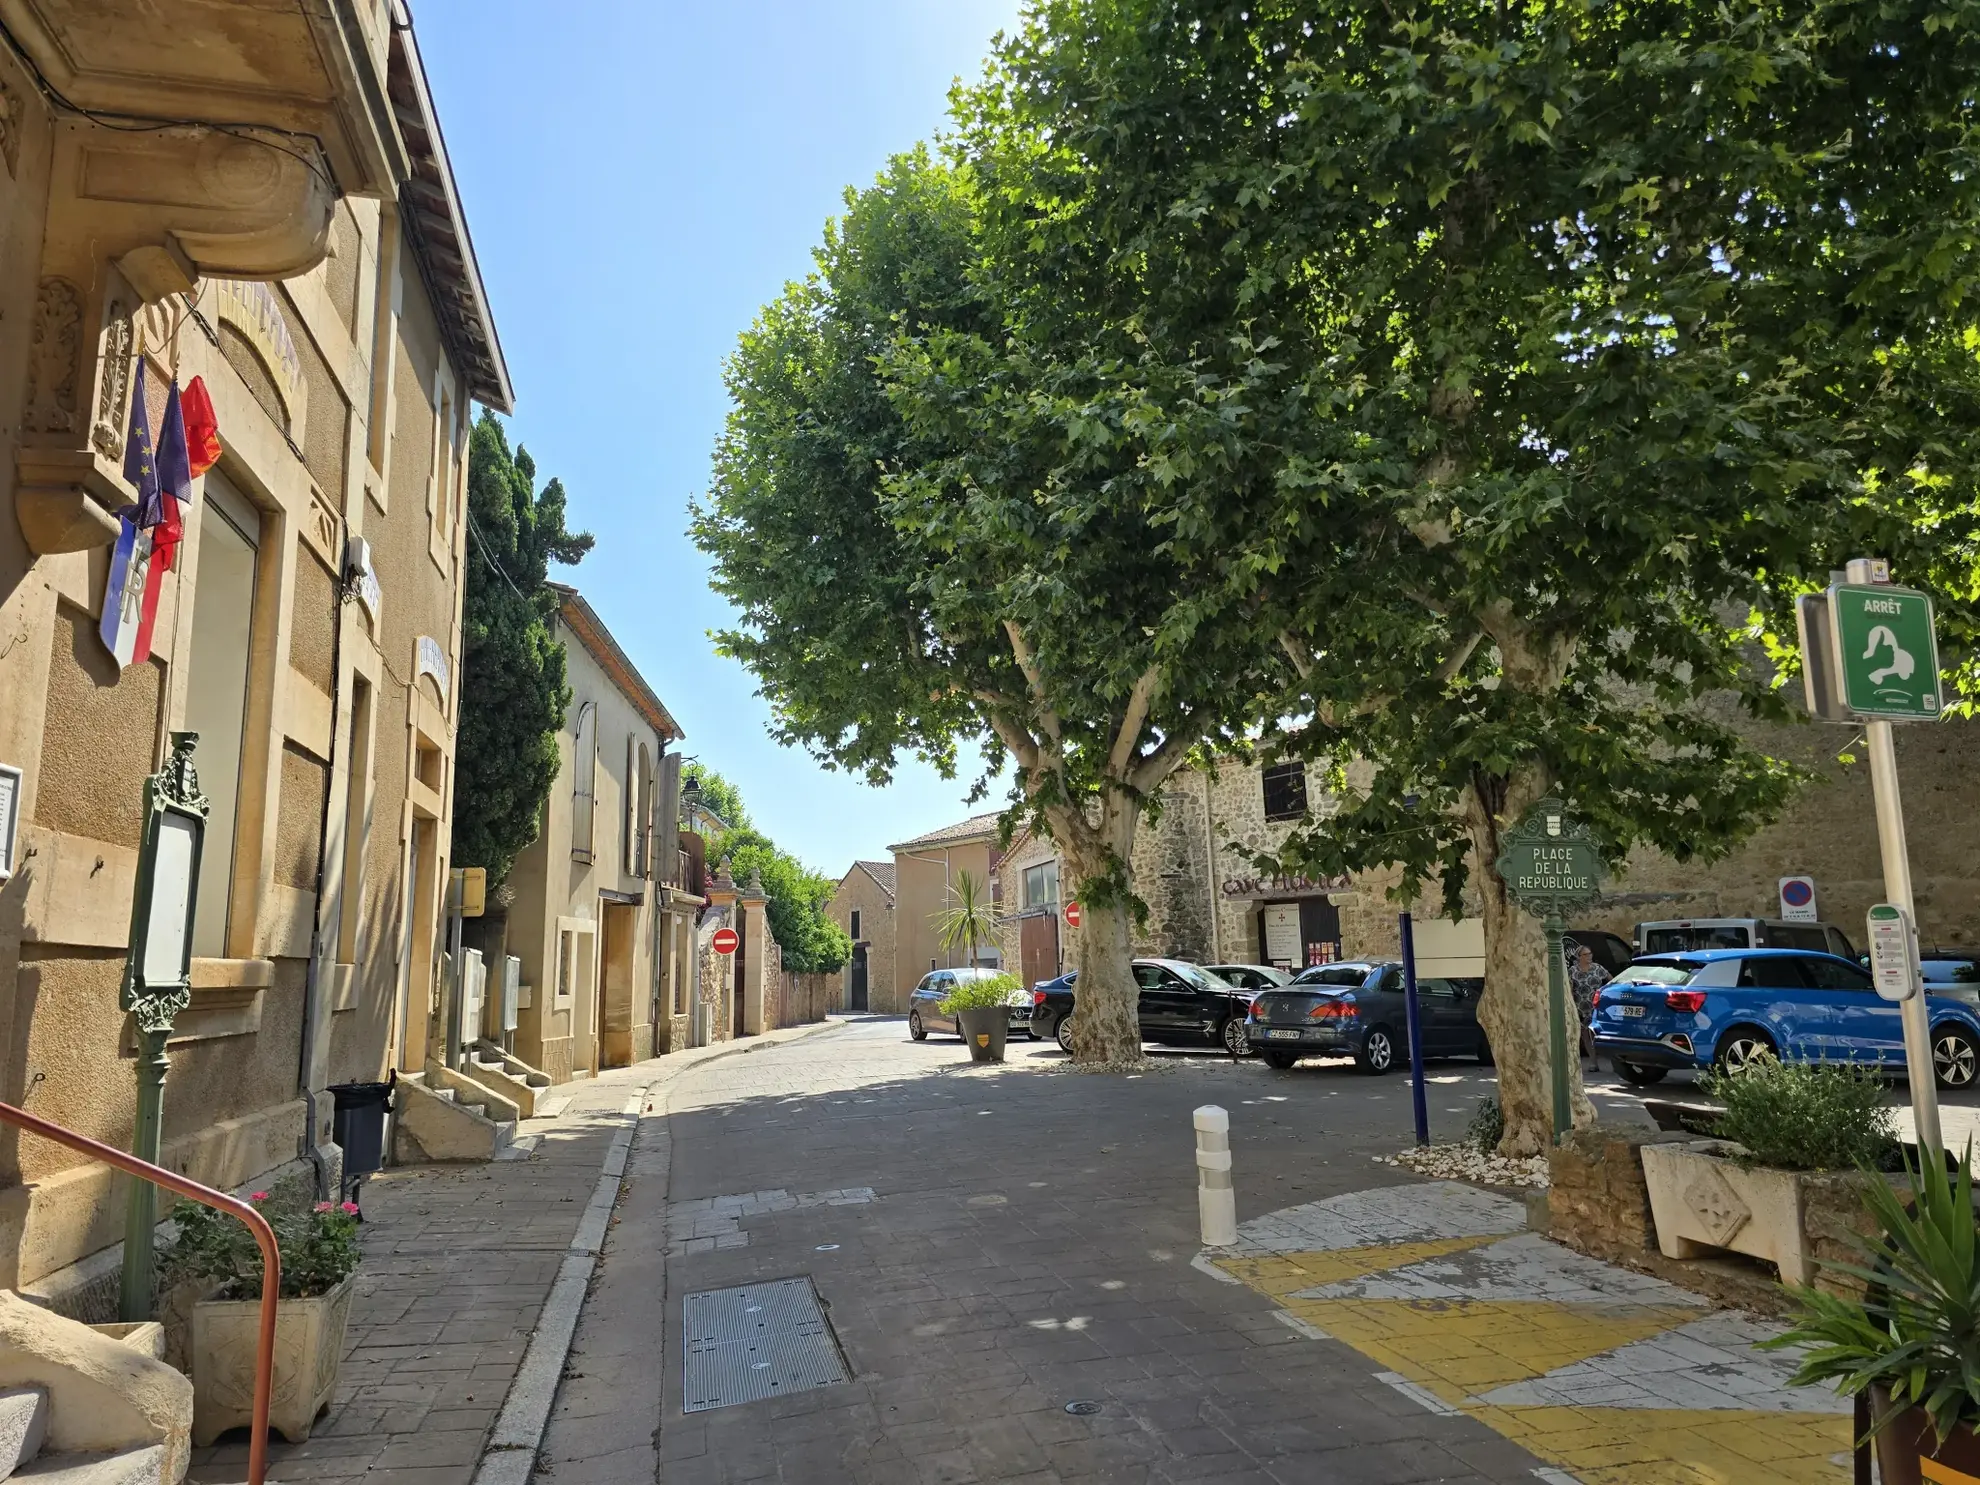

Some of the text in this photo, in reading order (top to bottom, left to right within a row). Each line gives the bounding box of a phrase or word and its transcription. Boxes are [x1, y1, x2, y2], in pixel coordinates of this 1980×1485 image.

[1864, 598, 1902, 615] ARRÊT
[1533, 848, 1573, 860] PLACE
[1535, 862, 1572, 875] DE LA
[1519, 876, 1588, 890] REPUBLIQUE
